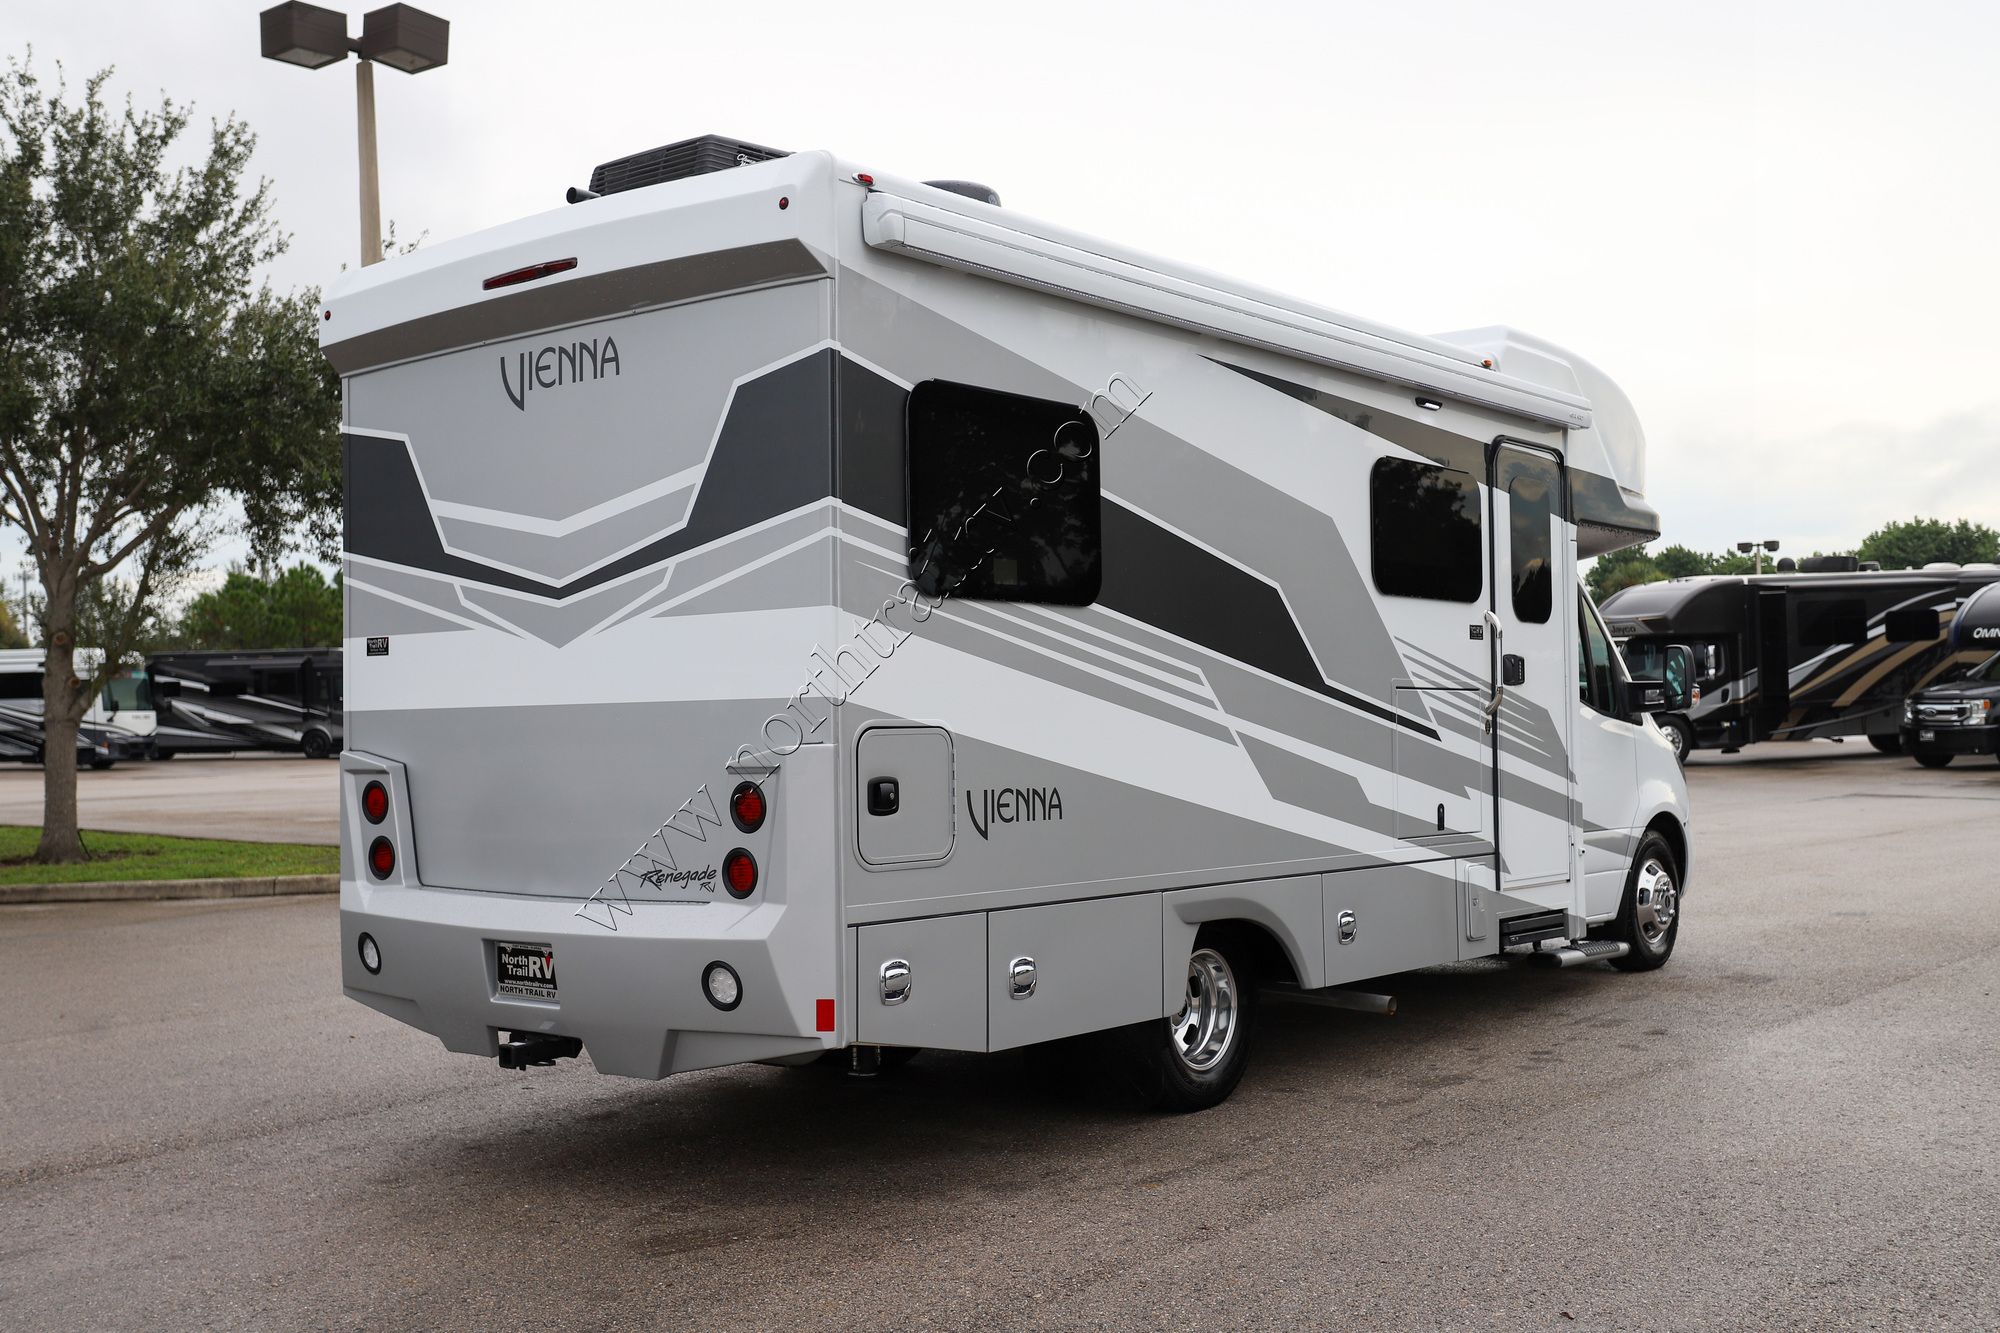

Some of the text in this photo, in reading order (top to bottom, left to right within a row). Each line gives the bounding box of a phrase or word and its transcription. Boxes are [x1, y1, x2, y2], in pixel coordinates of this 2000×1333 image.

[500, 336, 620, 412] VIENNA
[966, 787, 1063, 840] VIENNA
[640, 864, 717, 891] Renegade
[699, 881, 717, 893] RV
[502, 953, 528, 965] North
[528, 956, 554, 979] RV
[507, 965, 528, 976] Trail
[500, 985, 556, 999] NORTH TRAIL RV
